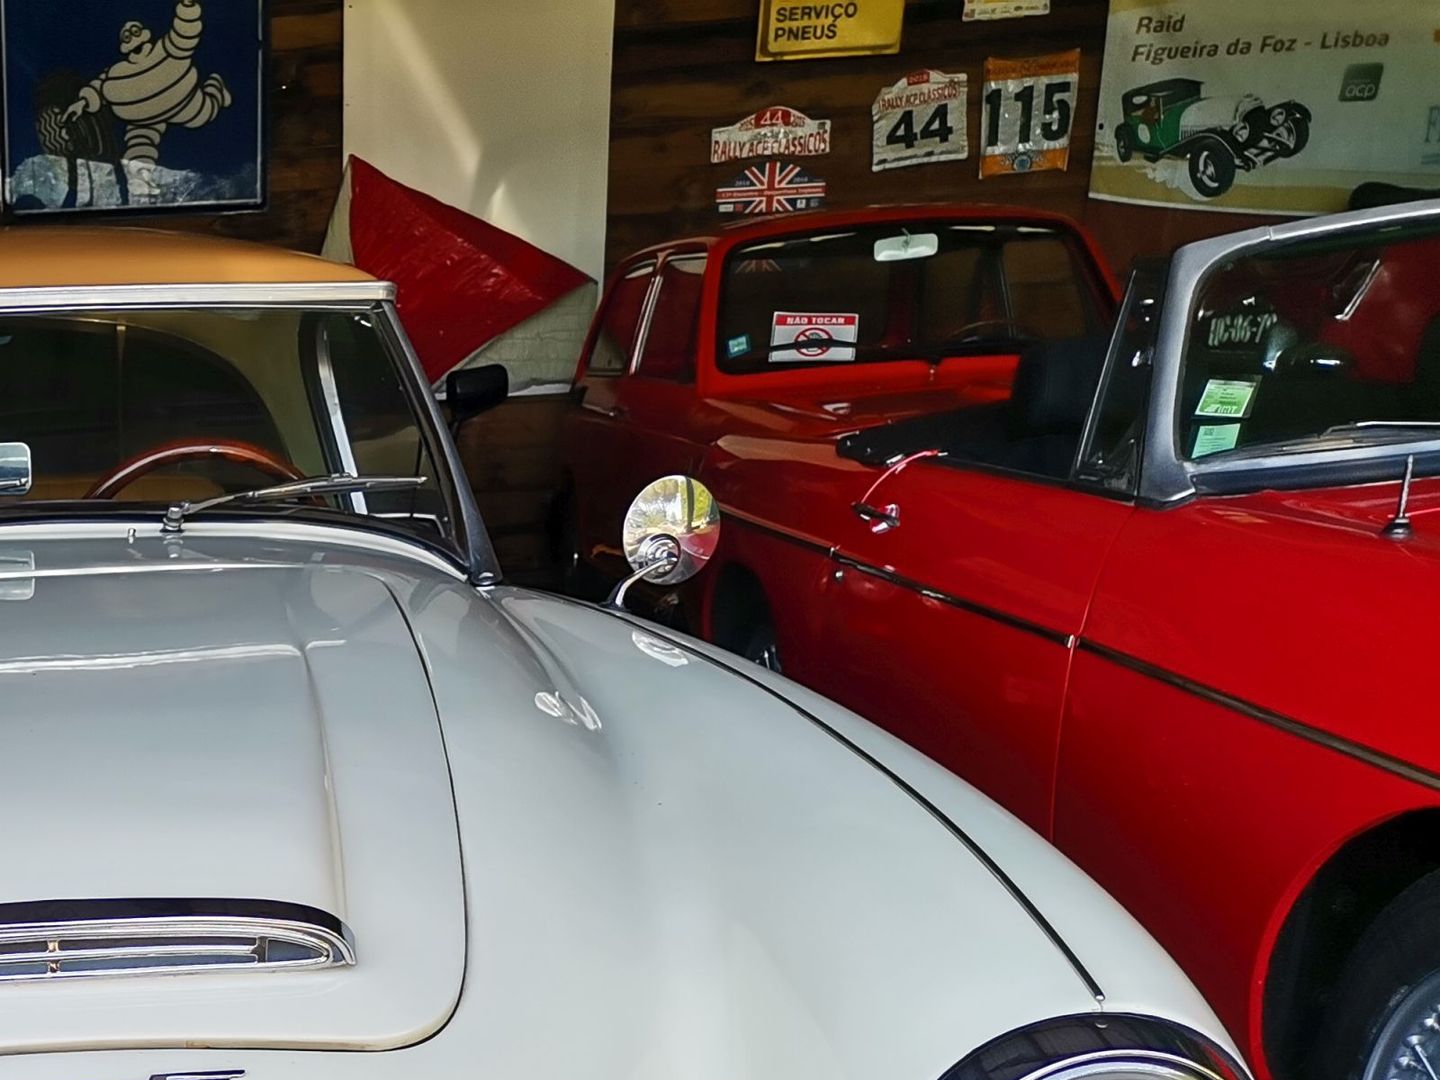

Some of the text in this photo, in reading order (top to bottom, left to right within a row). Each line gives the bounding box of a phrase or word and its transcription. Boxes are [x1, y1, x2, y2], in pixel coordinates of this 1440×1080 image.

[775, 2, 858, 23] SERVIÇO
[773, 24, 838, 42] PNEUS
[1135, 14, 1186, 35] Raid
[1131, 42, 1218, 66] Figueira
[1226, 38, 1252, 56] da
[1260, 35, 1298, 54] Foz
[1320, 30, 1390, 50] Lisboa
[1345, 83, 1376, 99] acp
[881, 95, 904, 111] RALLY
[985, 81, 1071, 147] 115
[886, 103, 953, 149] 44
[712, 139, 747, 161] RALLY
[786, 316, 846, 325] NÃO TOCAR
